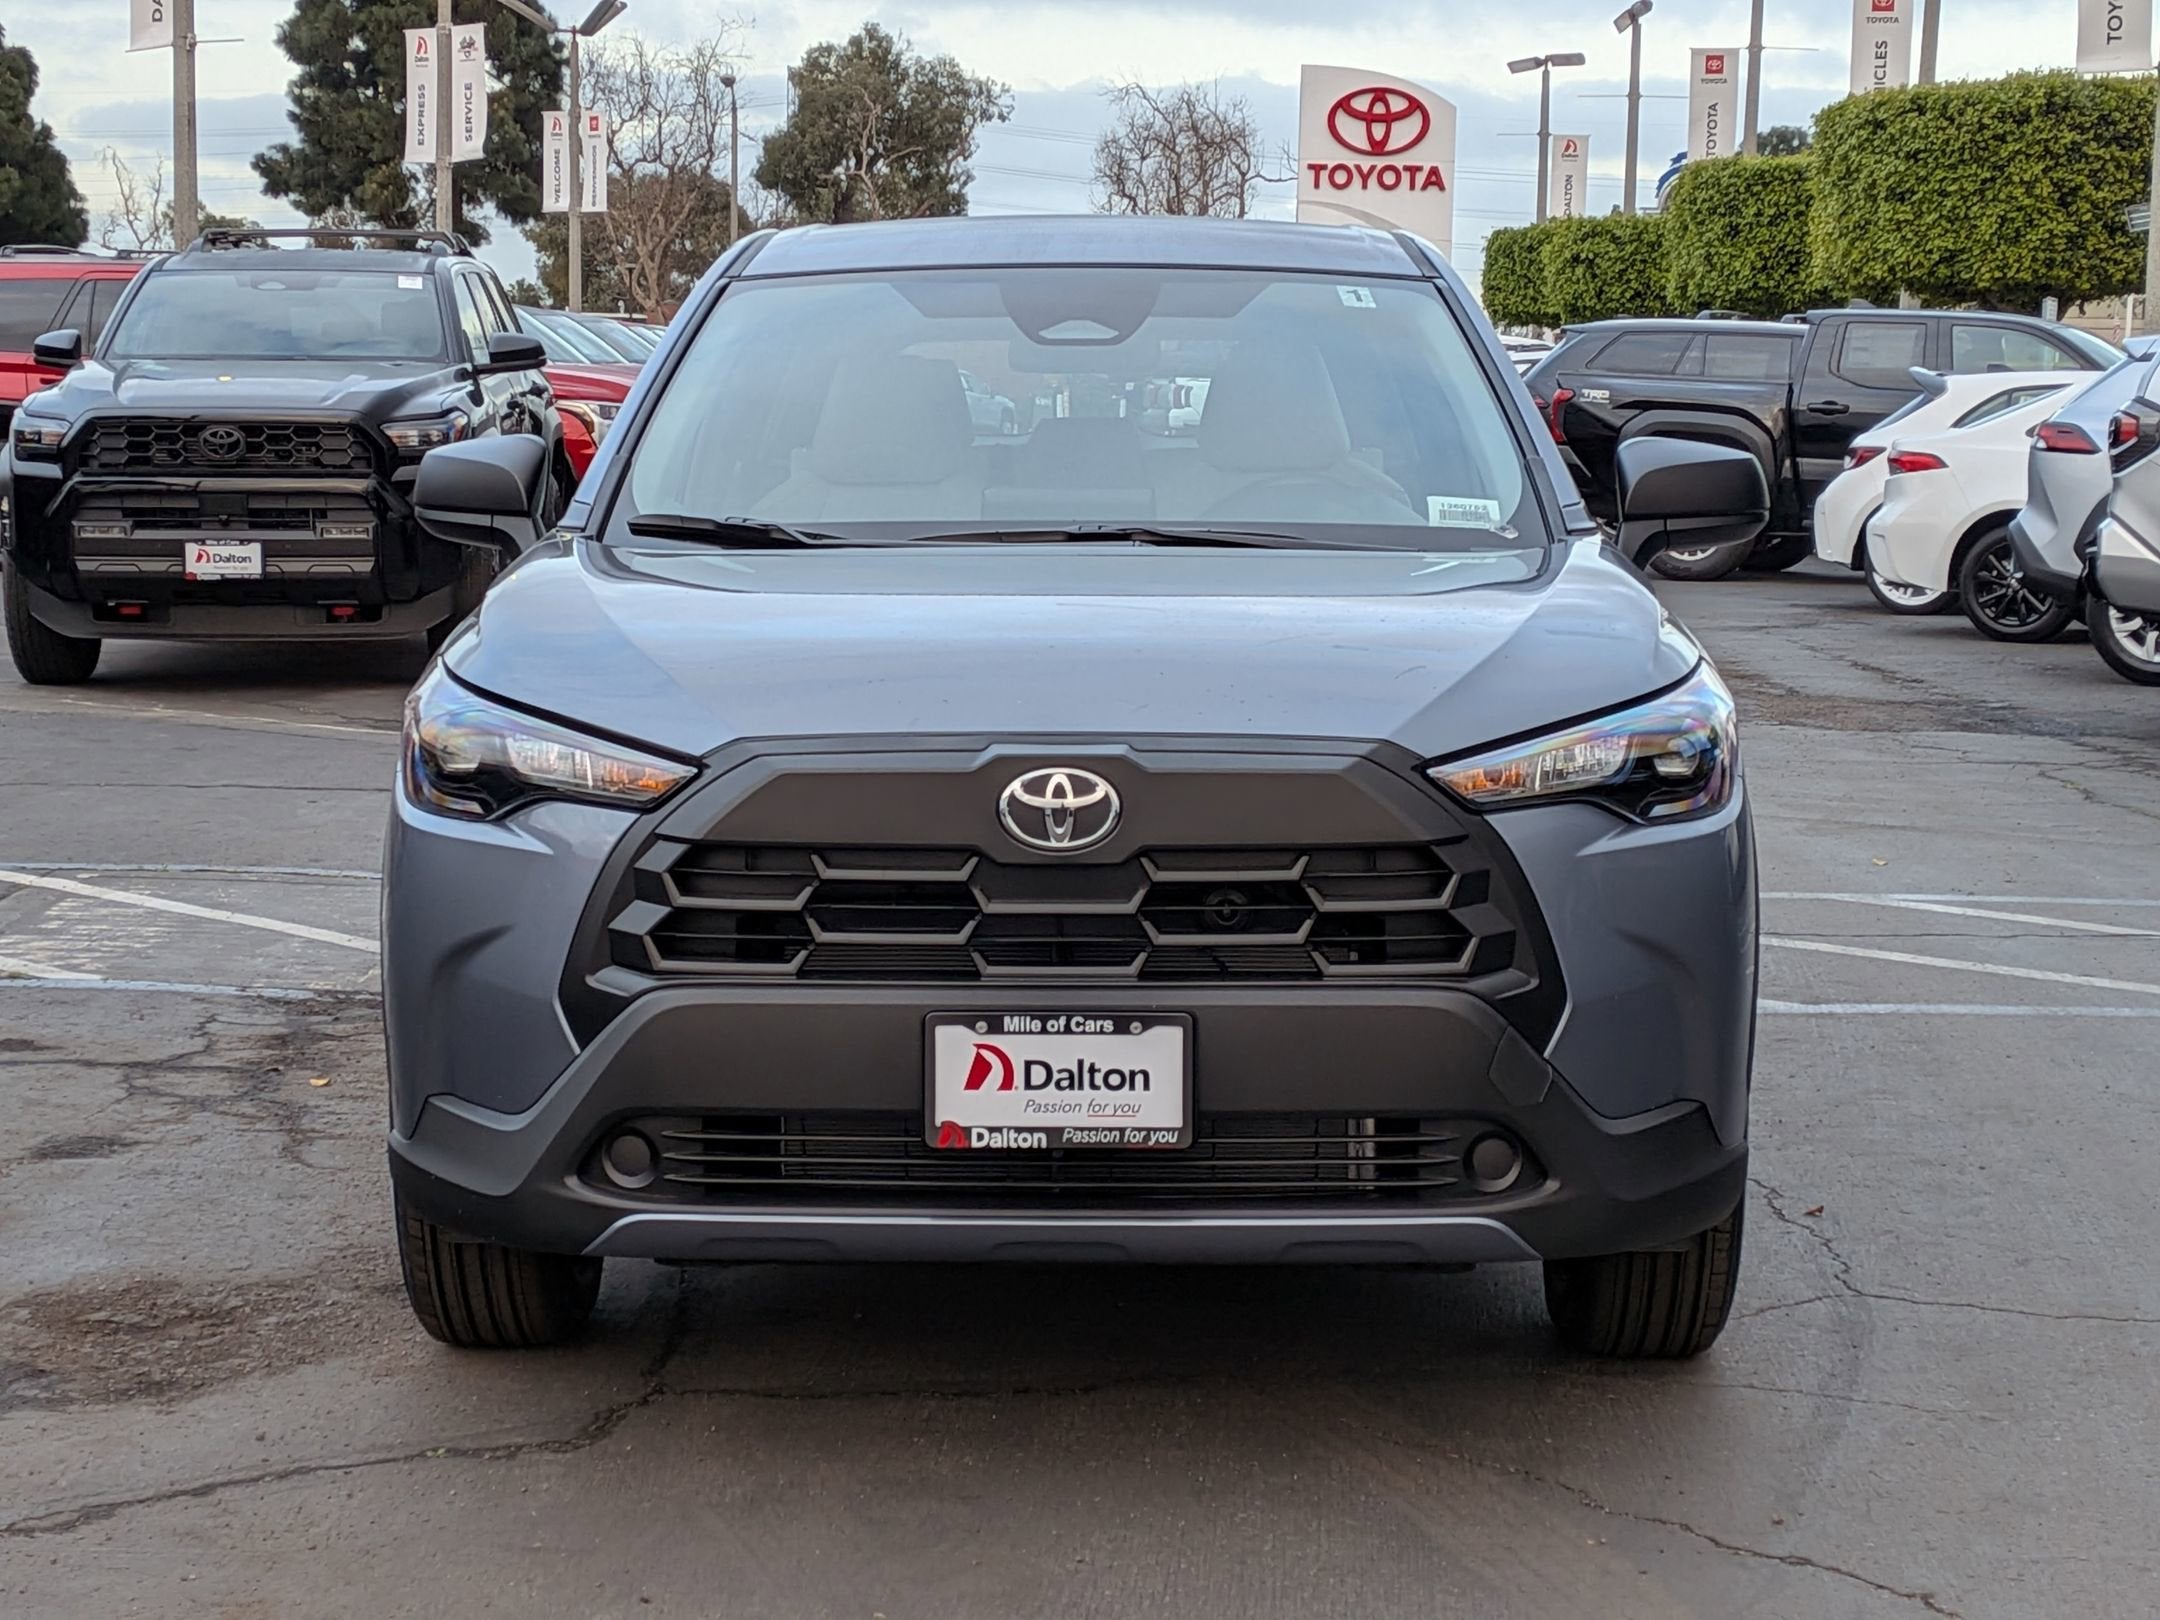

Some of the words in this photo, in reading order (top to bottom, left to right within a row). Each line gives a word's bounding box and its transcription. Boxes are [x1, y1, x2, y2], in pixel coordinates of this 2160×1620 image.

[1866, 16, 1900, 24] TOYOTA
[417, 83, 425, 146] EXPRESS
[464, 82, 472, 143] SERVICE
[1706, 101, 1719, 157] TOYOTA
[1307, 163, 1446, 192] TOYOTA
[212, 553, 252, 564] Dalton
[1003, 1016, 1041, 1033] Mile
[1046, 1016, 1067, 1033] of
[1070, 1016, 1115, 1033] Cars
[1023, 1058, 1151, 1092] Dalton
[1023, 1099, 1082, 1114] Passion
[1086, 1098, 1109, 1115] for
[1112, 1101, 1142, 1116] you
[971, 1127, 1047, 1149] Dalton
[1062, 1127, 1121, 1144] Passion
[1123, 1127, 1147, 1144] for
[1149, 1129, 1179, 1146] you
